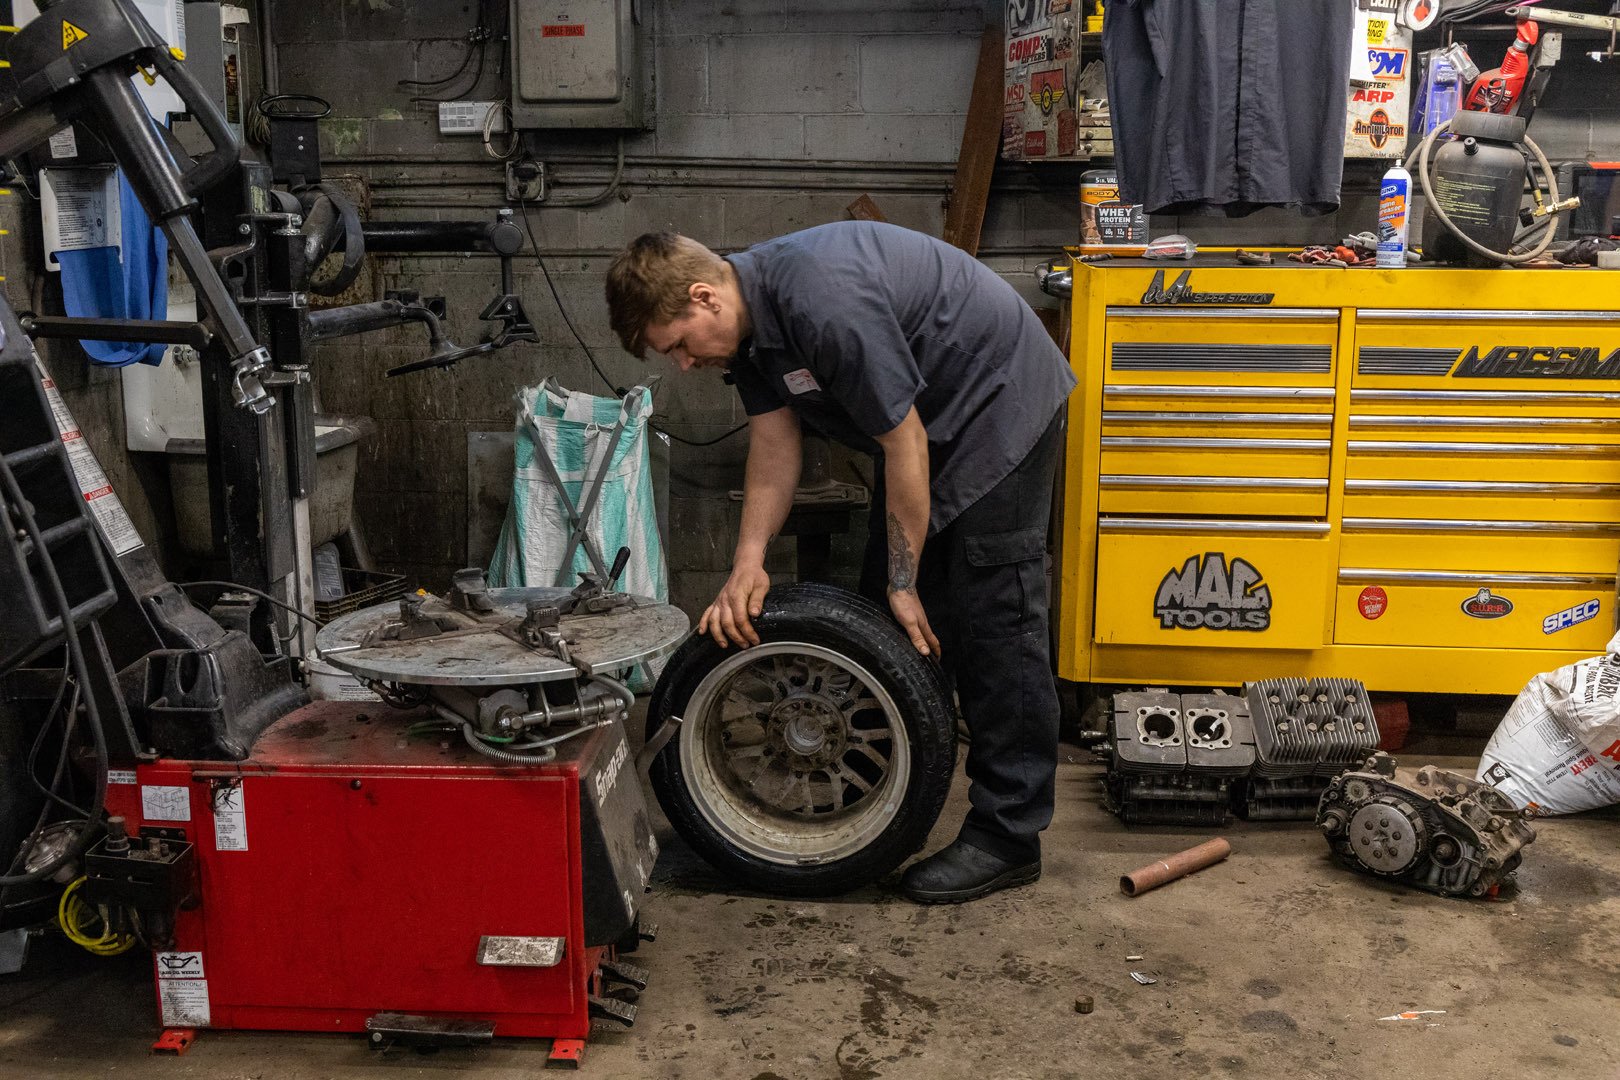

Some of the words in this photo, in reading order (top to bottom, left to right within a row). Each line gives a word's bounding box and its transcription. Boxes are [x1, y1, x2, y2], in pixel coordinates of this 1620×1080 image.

[1008, 36, 1041, 62] COMP
[1006, 84, 1025, 104] MSD
[1352, 90, 1395, 103] ARP
[1098, 208, 1133, 217] WHEY
[1154, 552, 1272, 609] MAC
[1154, 608, 1270, 631] TOOLS
[1543, 599, 1600, 632] SPEC
[595, 738, 629, 808] Snap-on
